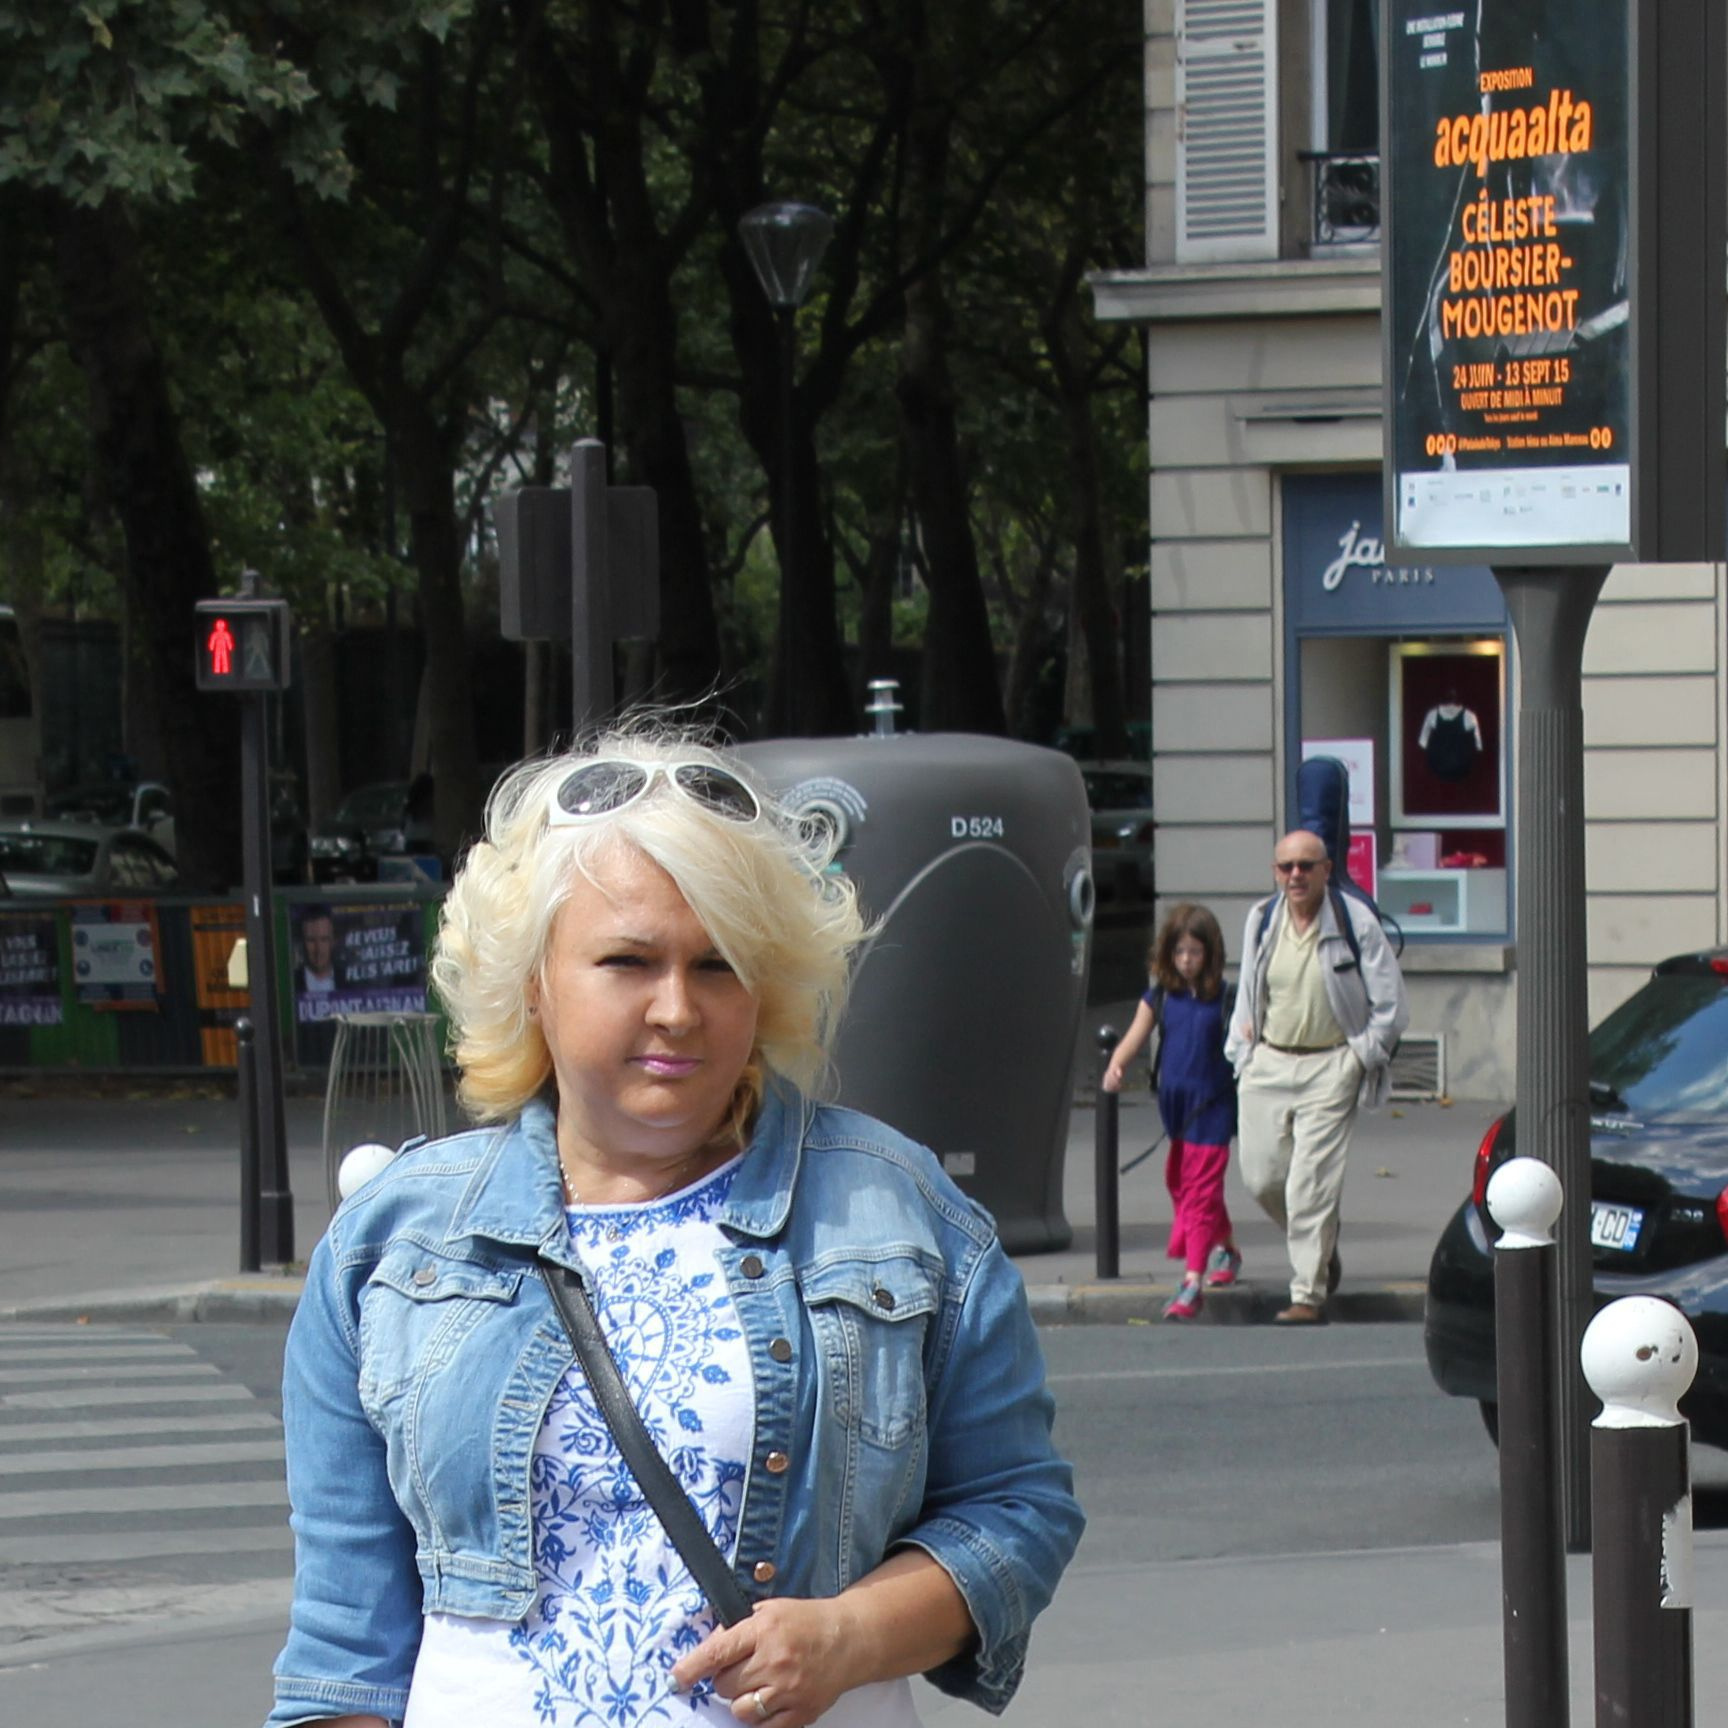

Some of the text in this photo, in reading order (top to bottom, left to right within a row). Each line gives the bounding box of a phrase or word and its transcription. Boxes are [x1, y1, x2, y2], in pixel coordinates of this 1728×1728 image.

[1480, 67, 1533, 93] EXPOSITION
[1434, 88, 1591, 177] acquaalta
[1462, 187, 1557, 243] CÉLESTE
[1449, 243, 1573, 293] BOURSIER-
[1442, 289, 1580, 340] MOUGENOT
[1453, 364, 1467, 388] 24
[1469, 363, 1495, 388] JUIN
[1505, 361, 1520, 387] 13
[1522, 359, 1551, 385] SEPT
[1554, 358, 1569, 383] 15
[1490, 390, 1502, 408] DE
[1371, 568, 1434, 583] PARIS
